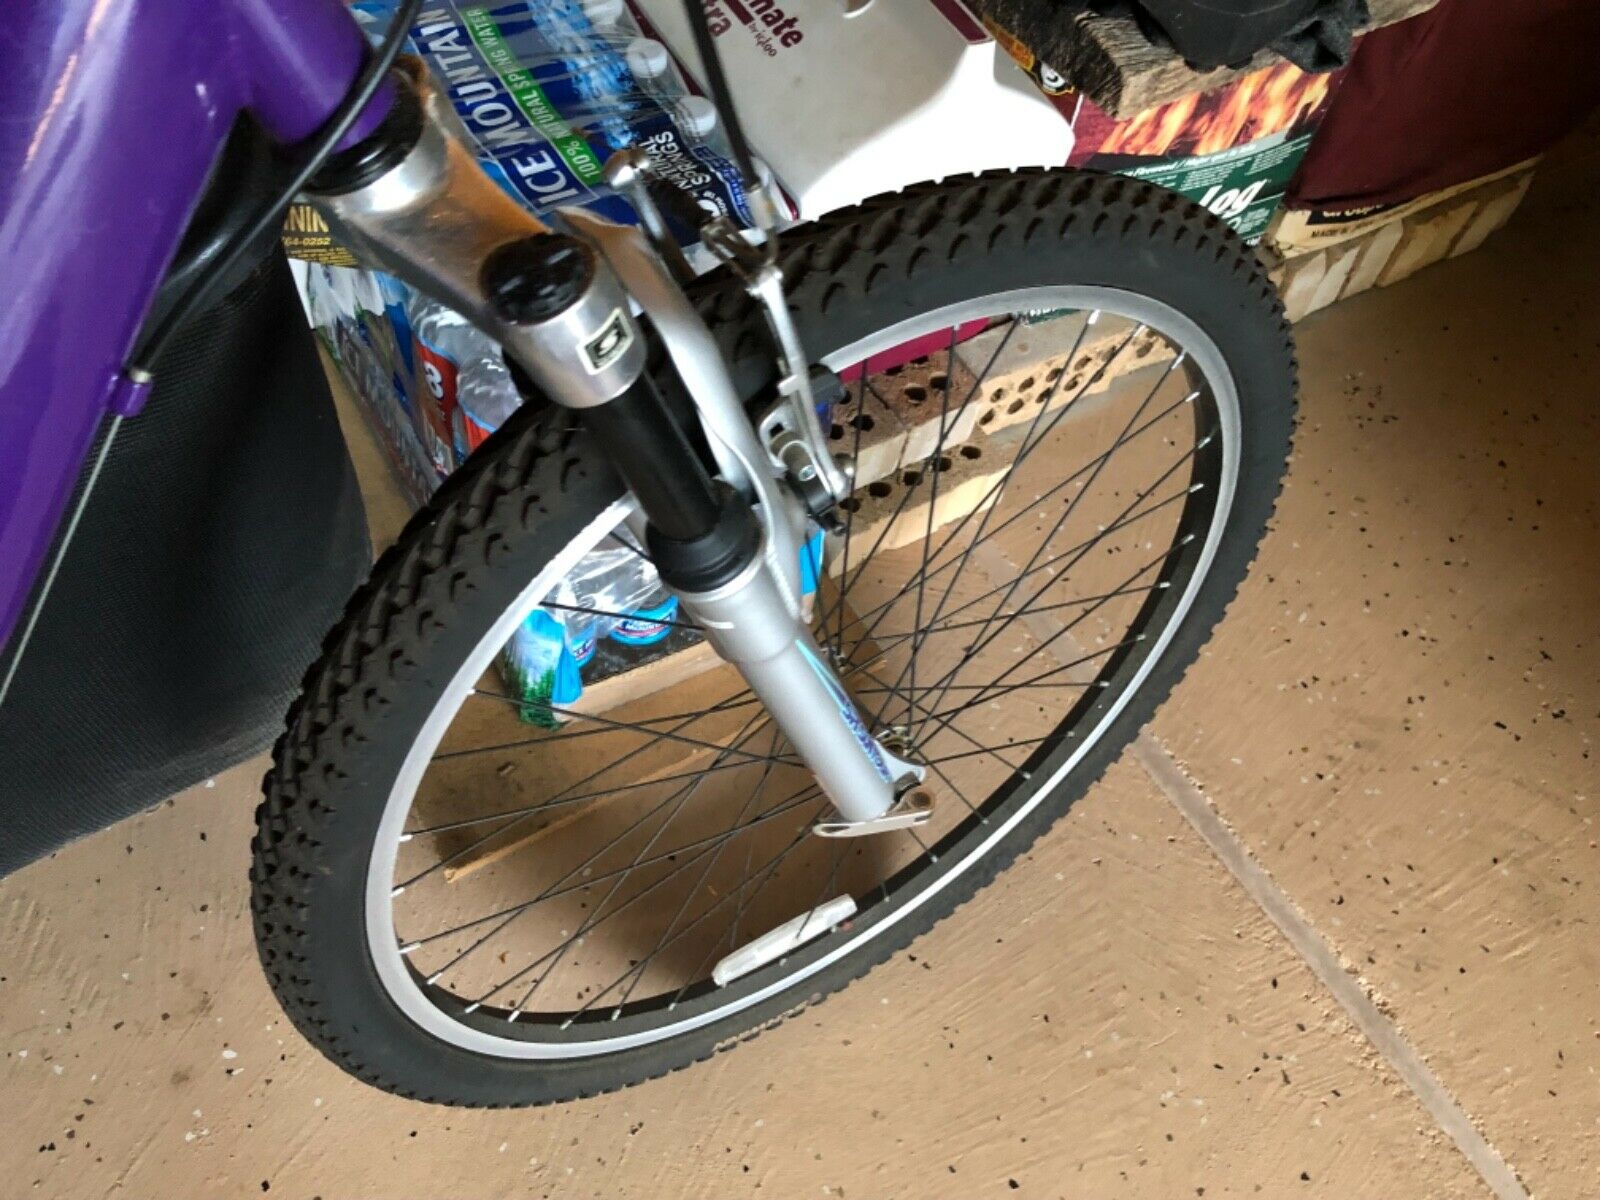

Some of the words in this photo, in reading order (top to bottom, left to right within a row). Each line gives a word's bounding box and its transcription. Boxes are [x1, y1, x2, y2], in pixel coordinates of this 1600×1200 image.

[466, 9, 499, 48] WATER
[755, 30, 778, 57] igloo
[416, 8, 538, 149] MOUNTAIN
[511, 150, 579, 204] ICE
[562, 141, 601, 178] 100%
